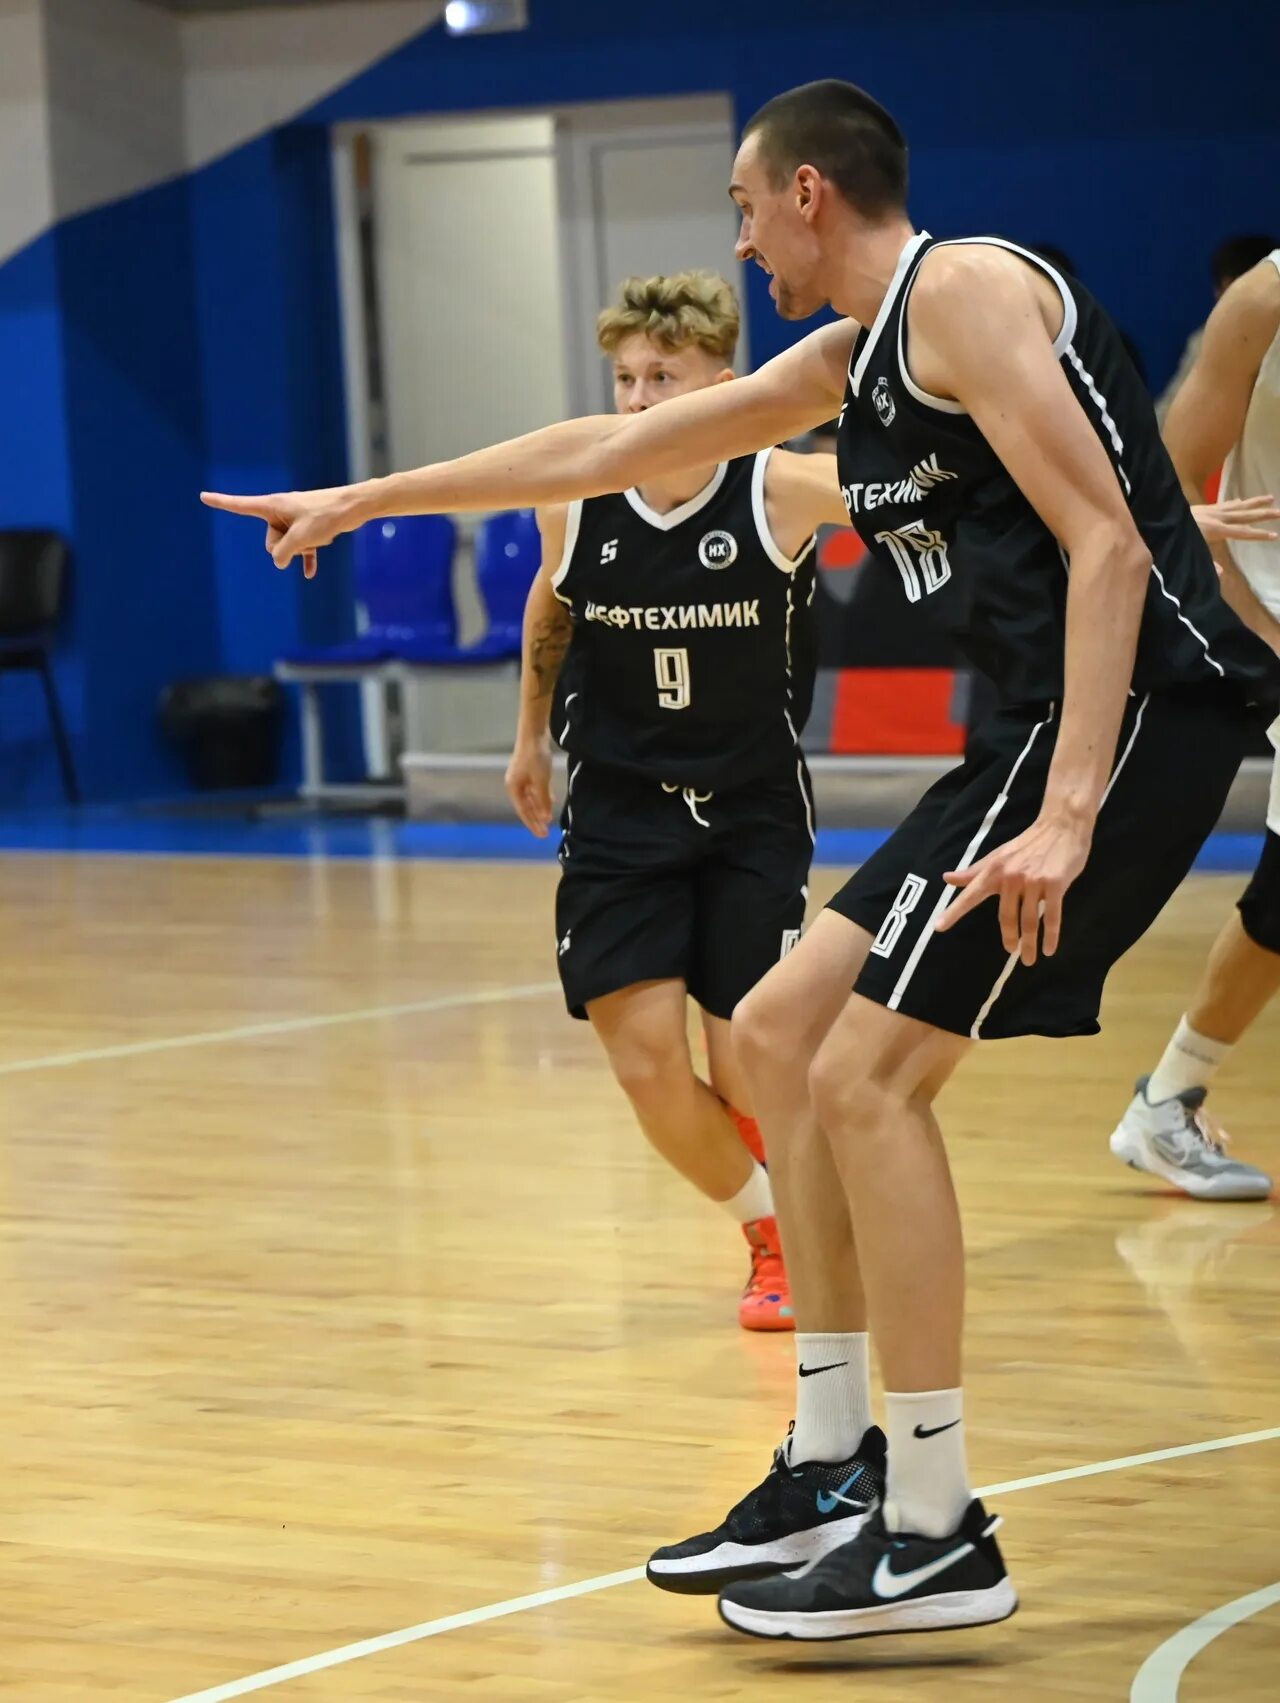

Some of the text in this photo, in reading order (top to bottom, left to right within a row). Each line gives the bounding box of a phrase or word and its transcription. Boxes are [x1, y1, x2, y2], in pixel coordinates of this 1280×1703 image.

[709, 543, 726, 558] НХ
[874, 518, 951, 603] 18
[653, 648, 691, 710] 9
[870, 872, 928, 959] 8
